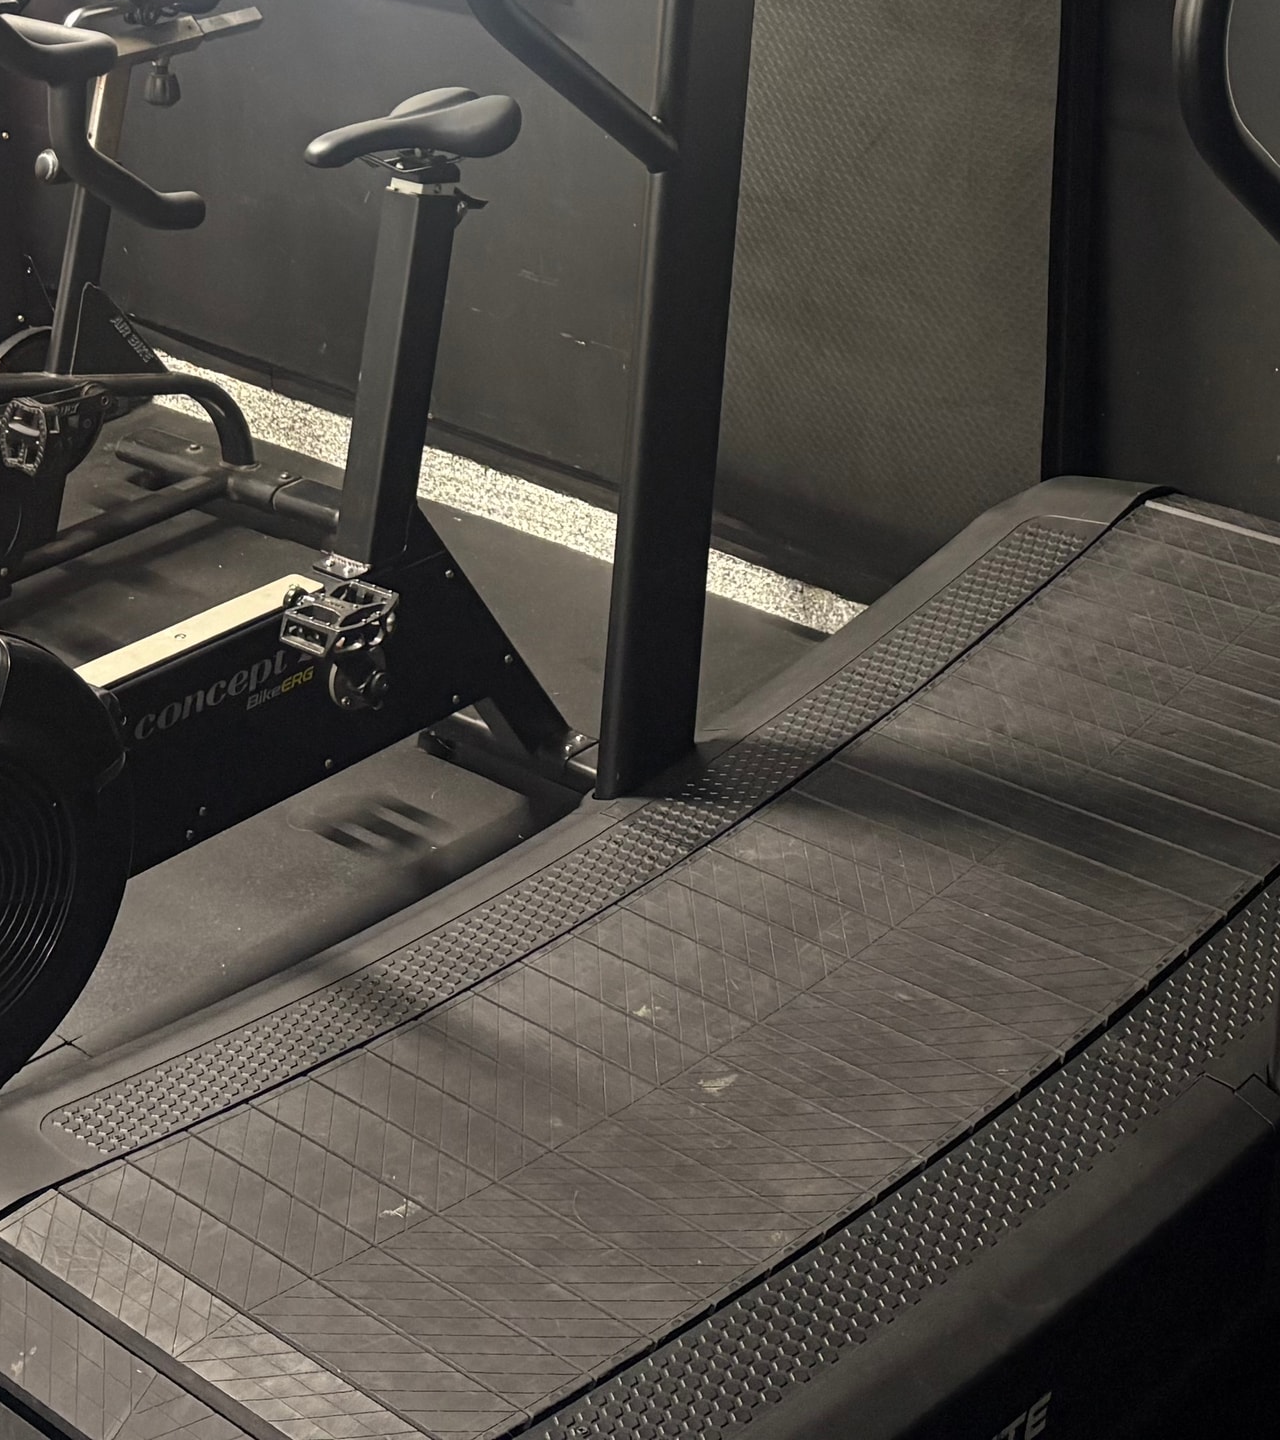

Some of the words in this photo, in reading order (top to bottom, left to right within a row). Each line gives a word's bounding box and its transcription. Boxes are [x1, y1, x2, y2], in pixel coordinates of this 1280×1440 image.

[134, 649, 288, 740] concept
[246, 666, 314, 711] BikeERG
[991, 1391, 1053, 1440] TE
